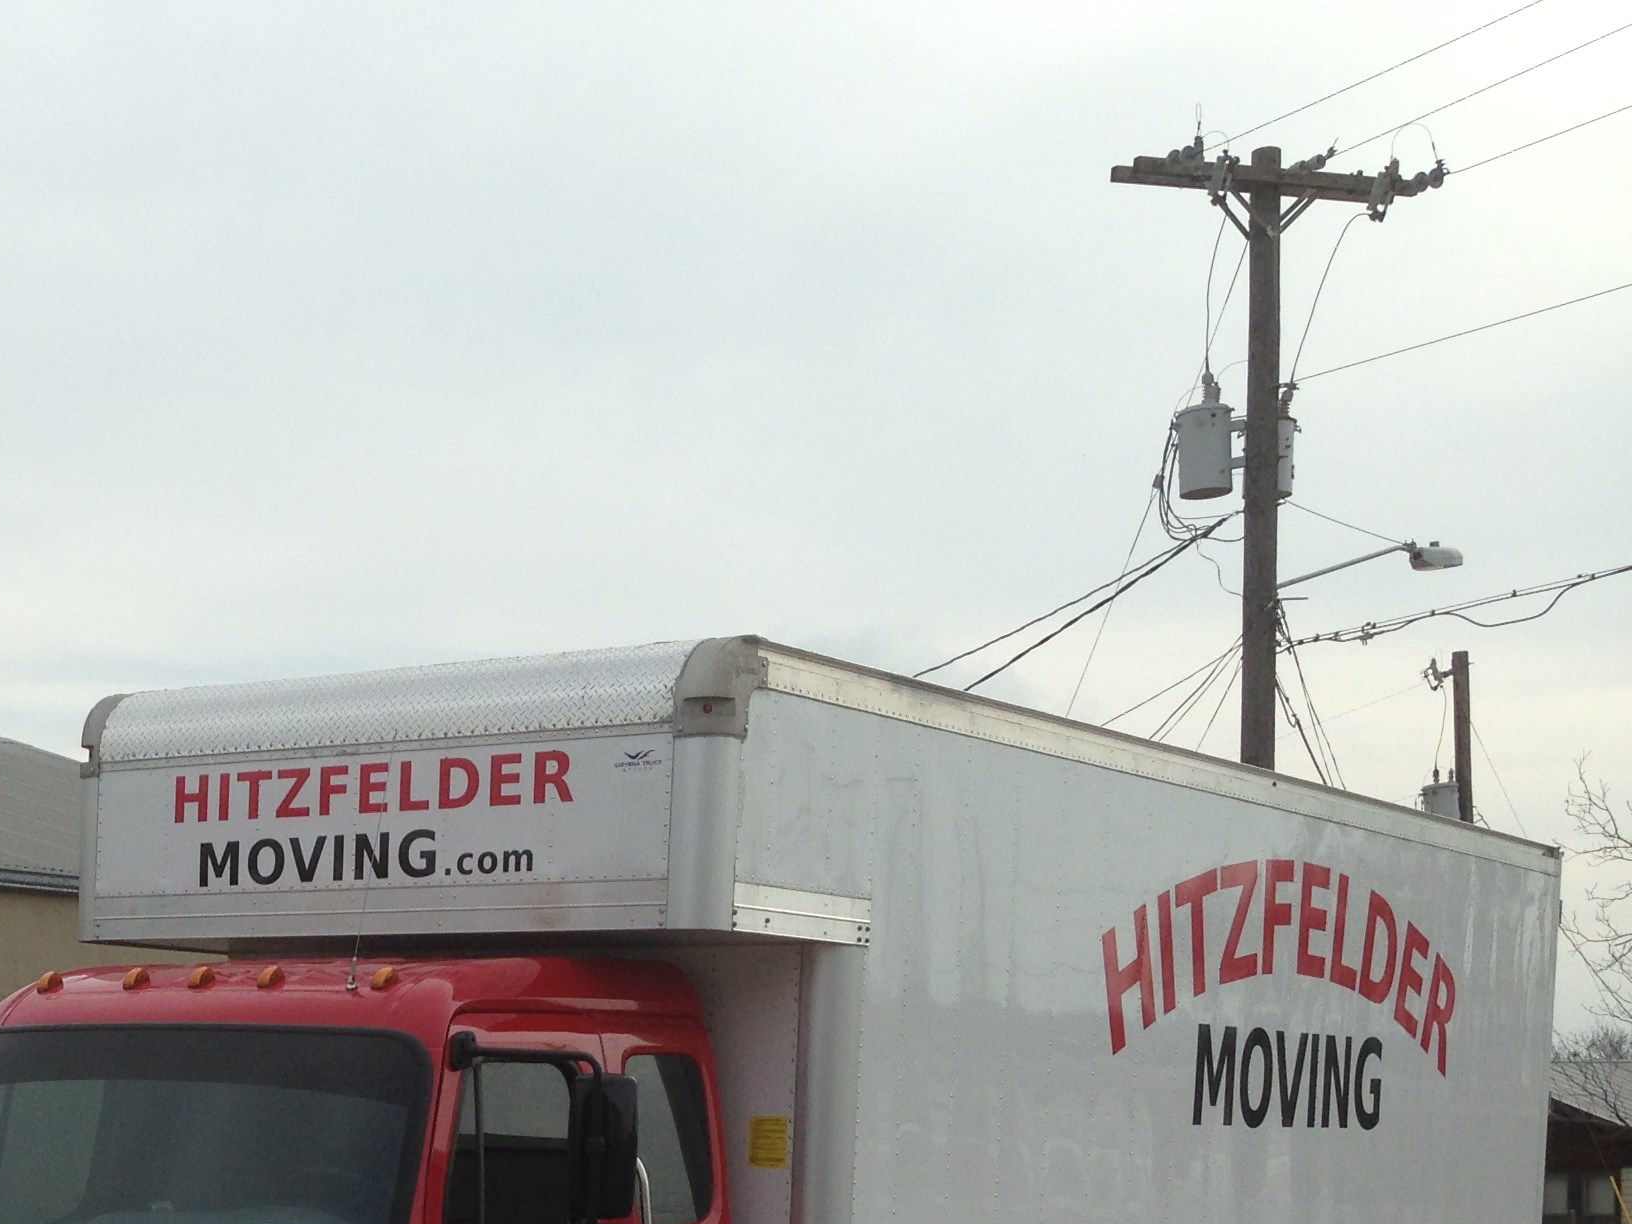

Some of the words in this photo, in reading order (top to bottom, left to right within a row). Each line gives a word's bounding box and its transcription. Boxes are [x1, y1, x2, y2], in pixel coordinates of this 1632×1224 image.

[173, 749, 575, 824] HITZFELDER
[198, 829, 535, 888] MOVING.com
[1101, 858, 1457, 1080] HITZFELDER
[1192, 1023, 1383, 1131] MOVING
